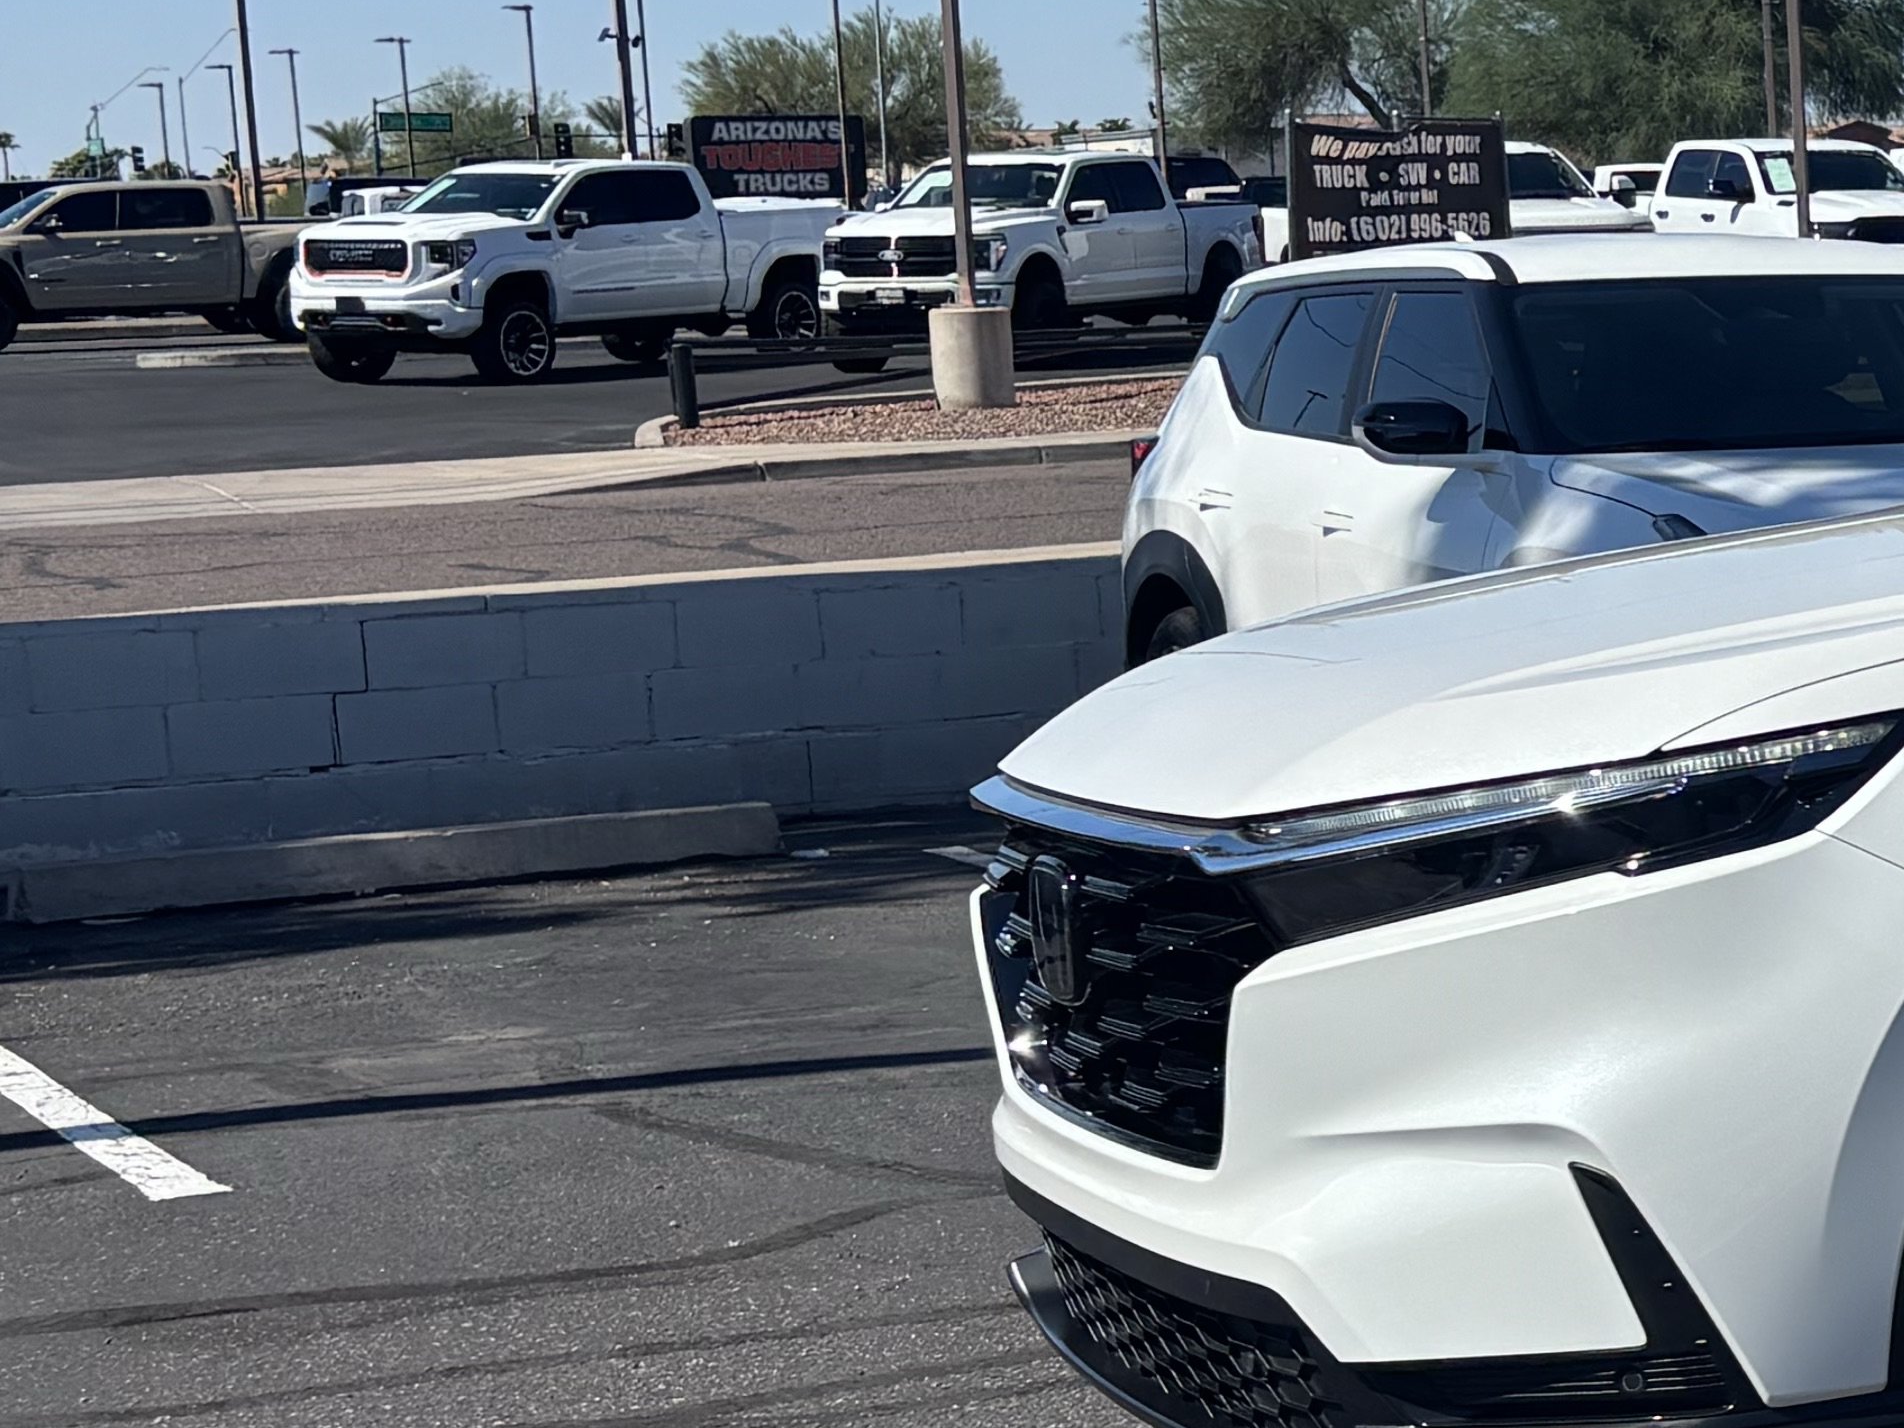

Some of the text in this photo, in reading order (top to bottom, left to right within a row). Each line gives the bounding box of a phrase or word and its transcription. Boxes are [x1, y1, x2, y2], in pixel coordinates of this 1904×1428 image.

[711, 121, 842, 142] ARIZONA'S
[1311, 134, 1343, 158] We
[1342, 140, 1378, 160] pay
[1421, 131, 1442, 154] for
[1445, 134, 1481, 156] your
[733, 173, 830, 193] TRUCKS
[1313, 164, 1370, 188] TRUCK
[1448, 162, 1480, 185] CAR
[1307, 211, 1490, 242] Info: (602) 996-5626
